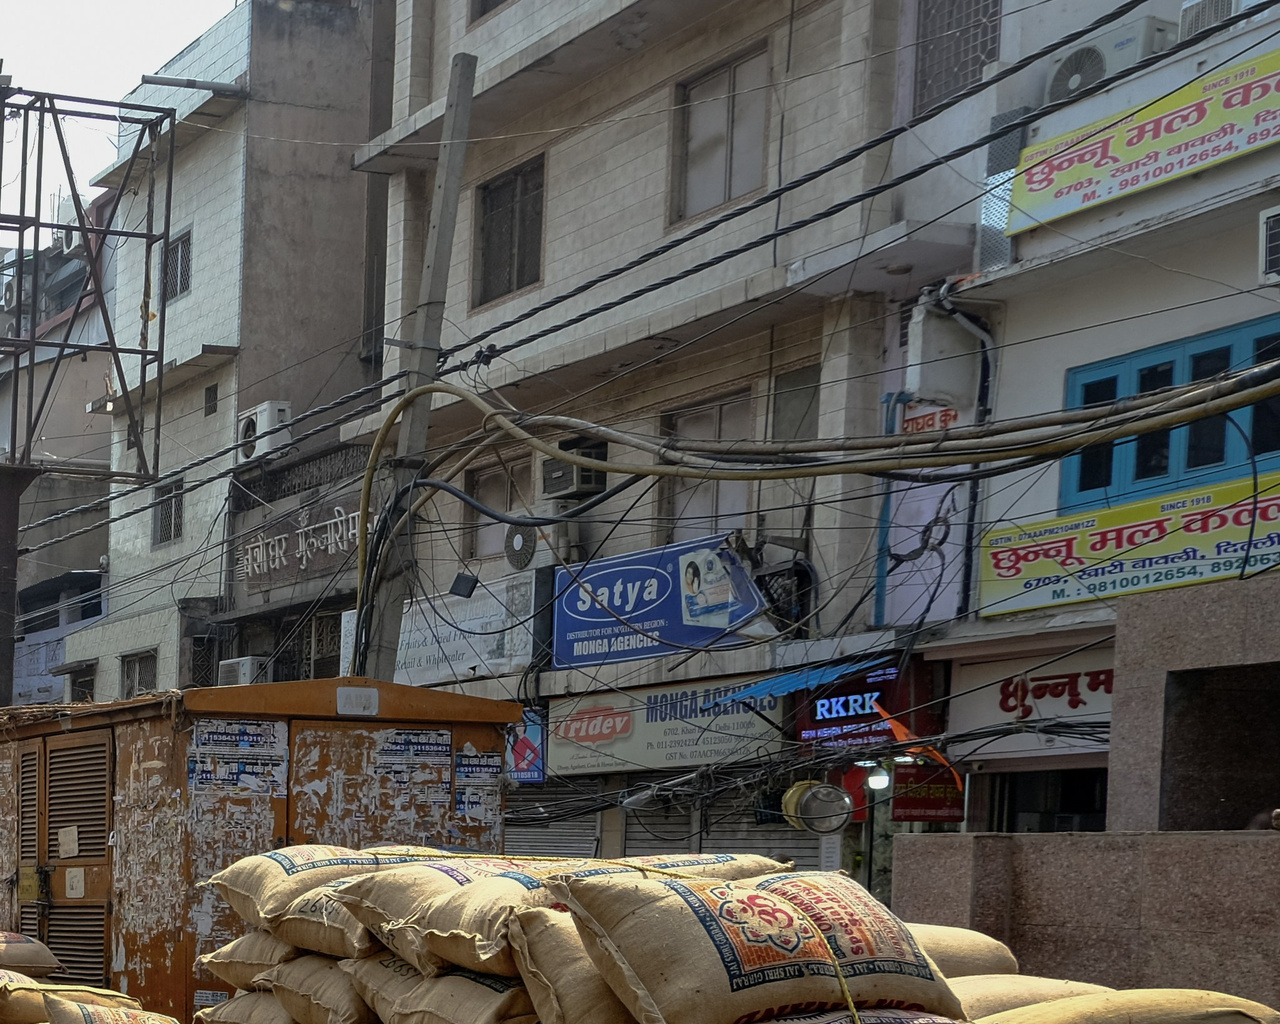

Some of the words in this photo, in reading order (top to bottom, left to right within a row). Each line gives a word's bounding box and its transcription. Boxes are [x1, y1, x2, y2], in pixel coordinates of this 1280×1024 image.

[1202, 76, 1231, 94] SINCE
[1233, 66, 1257, 83] 1918
[1125, 97, 1215, 148] मल
[1221, 70, 1280, 109] क
[1119, 140, 1240, 190] 9810012654,
[1053, 177, 1101, 199] 6703,
[1160, 501, 1187, 512] SINCE
[1190, 495, 1212, 507] 1918
[989, 536, 1012, 546] GSTIN
[1089, 517, 1174, 552] मल
[1023, 575, 1069, 590] 6703,
[1087, 566, 1203, 594] 9810012654,
[576, 577, 659, 612] Satya
[567, 628, 601, 640] DISTRIBUTOR
[601, 627, 613, 635] FOR
[643, 620, 665, 629] REGION
[400, 637, 420, 651] Fruits
[574, 639, 610, 656] MONGA
[611, 631, 660, 652] AGENCIES
[396, 657, 416, 671] Retail
[1084, 668, 1114, 694] म
[646, 690, 699, 723] MONGA
[816, 692, 880, 720] RKRK
[553, 713, 631, 739] Tridev
[666, 751, 680, 761] GST
[823, 892, 862, 927] Seeds
[710, 921, 727, 949] GIRRAJ
[822, 906, 864, 956] Special
[722, 949, 734, 963] SHRI
[875, 961, 902, 973] GIRRAJ
[730, 966, 739, 975] JAI
[765, 969, 785, 980] SHRI
[787, 965, 800, 976] JAI
[855, 963, 868, 973] JAI
[733, 973, 763, 989] GIRRAJ
